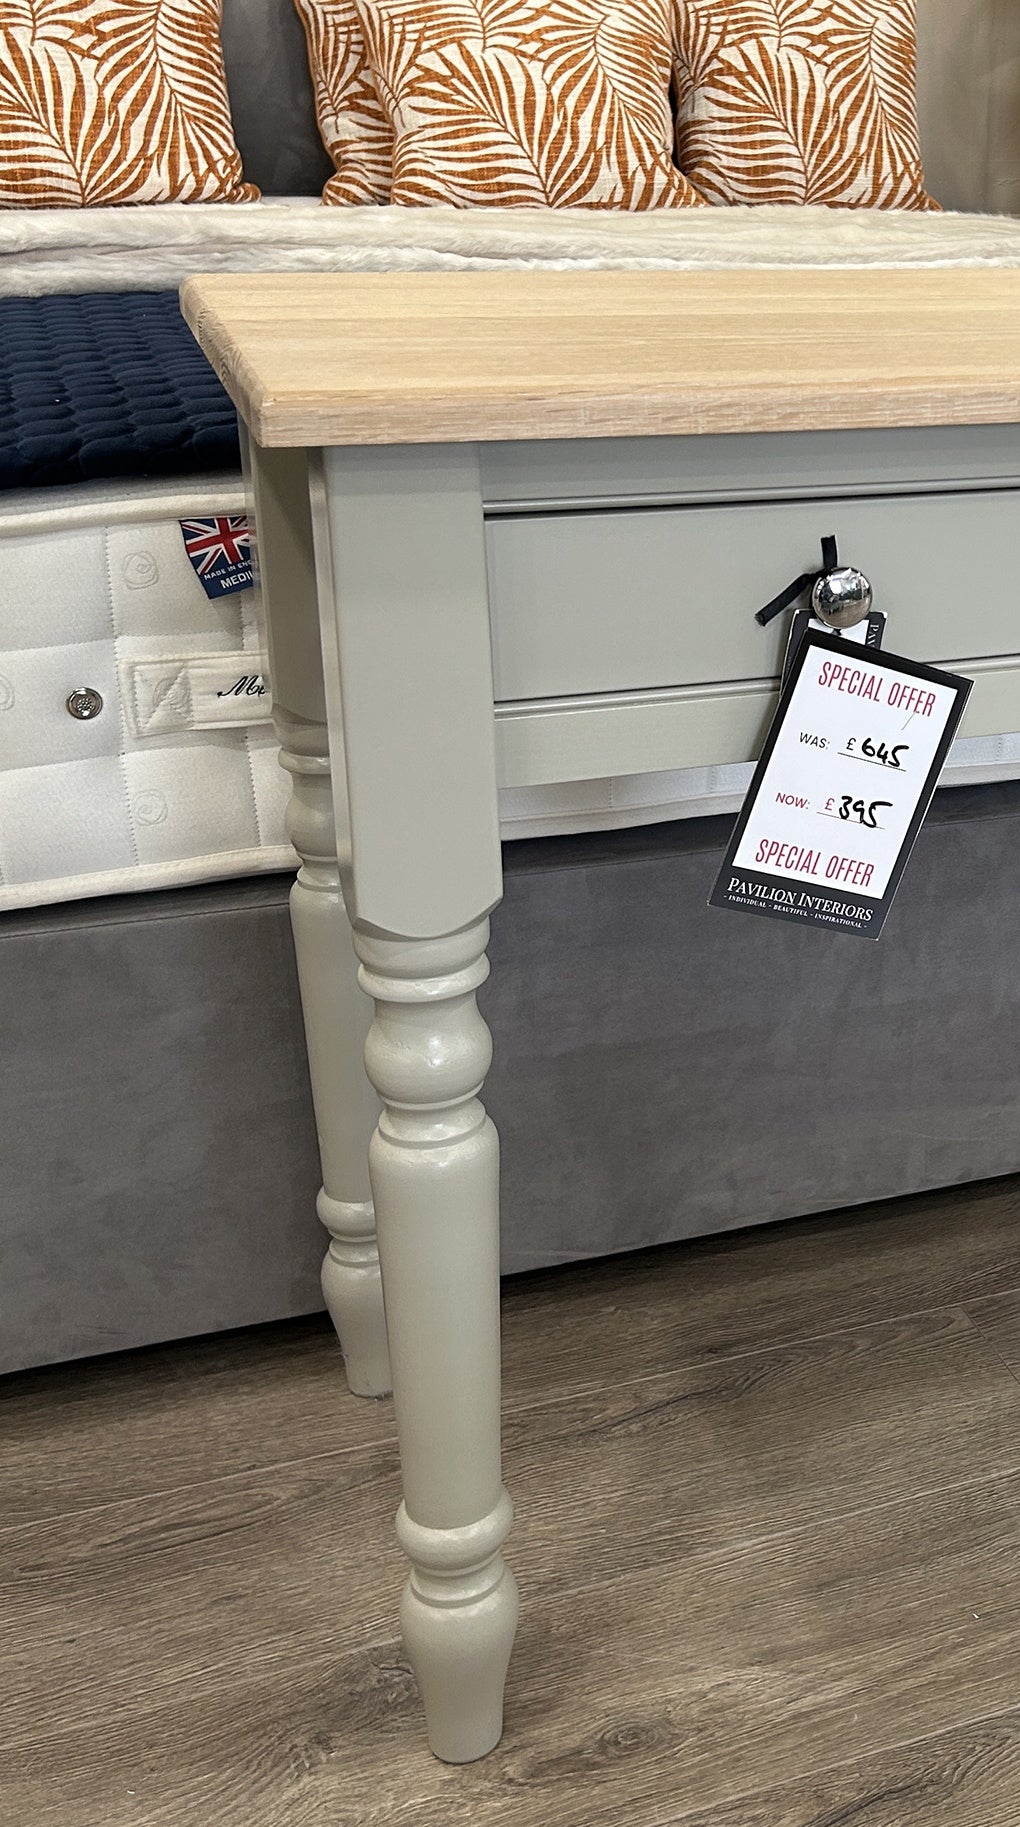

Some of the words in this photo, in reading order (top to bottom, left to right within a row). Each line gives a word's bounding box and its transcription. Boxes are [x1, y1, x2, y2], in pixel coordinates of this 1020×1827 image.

[203, 568, 227, 581] MADE
[818, 661, 884, 702] SPECIAL
[887, 682, 936, 717] OFFER
[799, 731, 831, 750] WAS:
[775, 792, 811, 810] NOW:
[755, 838, 822, 875] SPECIAL
[825, 855, 875, 887] OFFER
[727, 877, 796, 905] PAVILION
[795, 892, 874, 922] INTERIORS
[728, 895, 767, 908] INDIVIDUAL
[773, 904, 808, 917] BEAUTIFUL
[814, 912, 862, 929] INSPIRATIONAL
